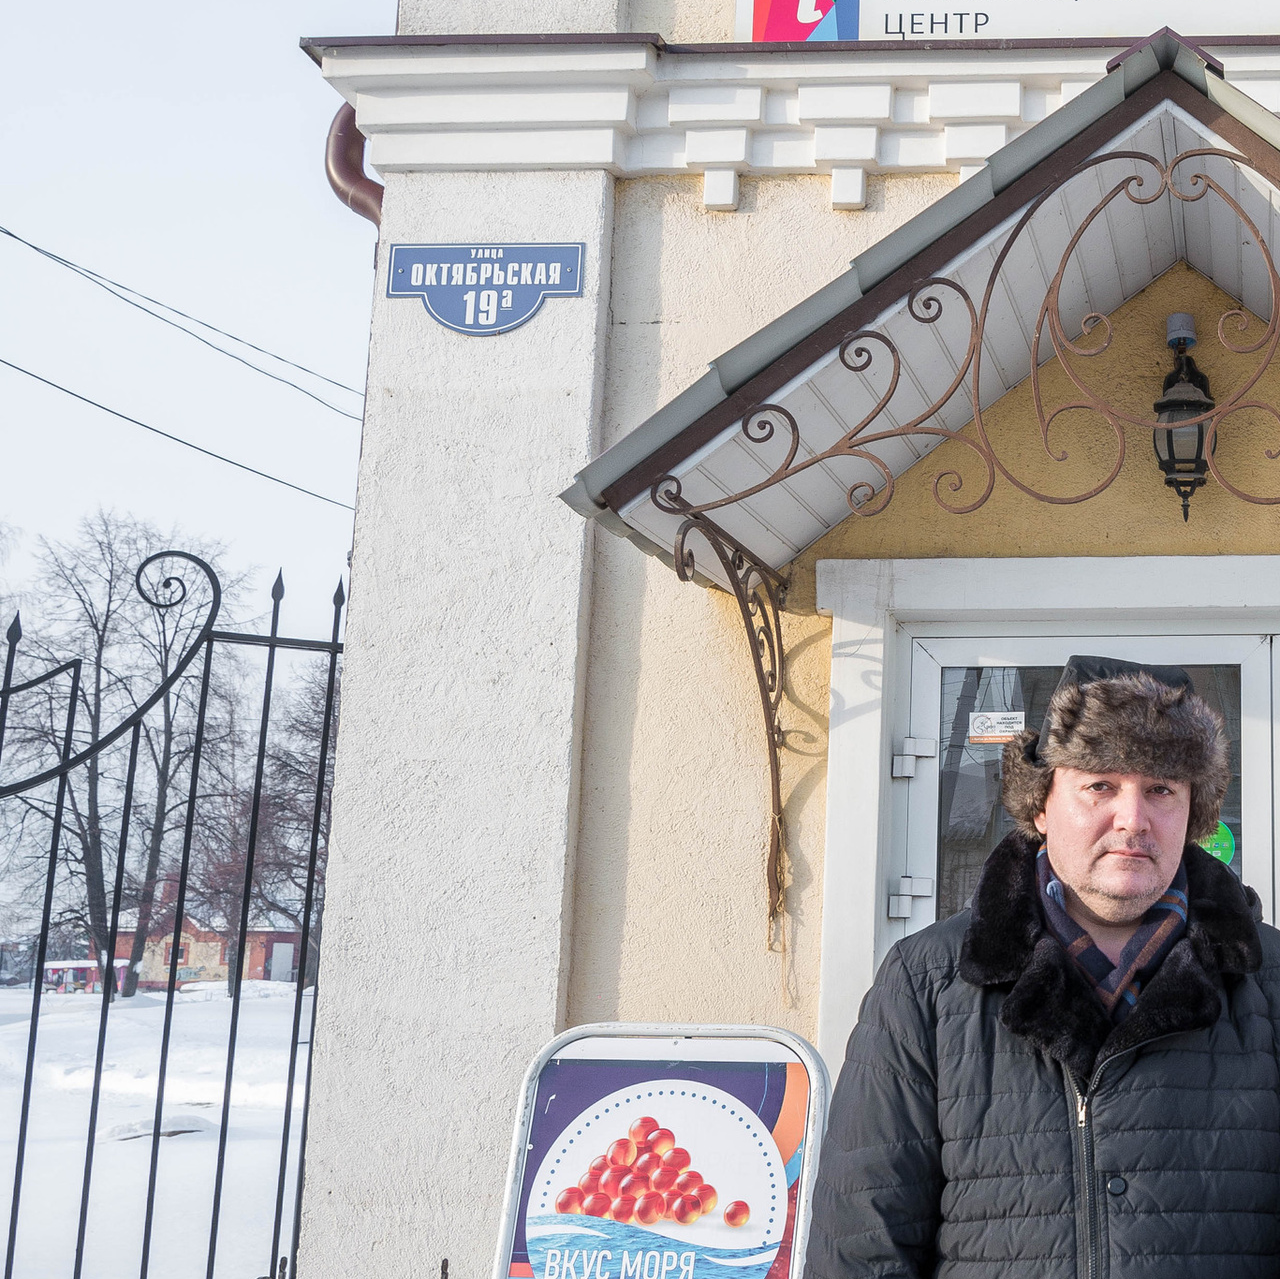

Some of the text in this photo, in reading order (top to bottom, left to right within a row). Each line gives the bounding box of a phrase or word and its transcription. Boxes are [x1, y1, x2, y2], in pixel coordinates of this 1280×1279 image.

[884, 12, 990, 40] ЦЕНТР
[470, 248, 504, 259] УЛИЦА
[410, 262, 562, 286] ОКТЯБРЬСКАЯ
